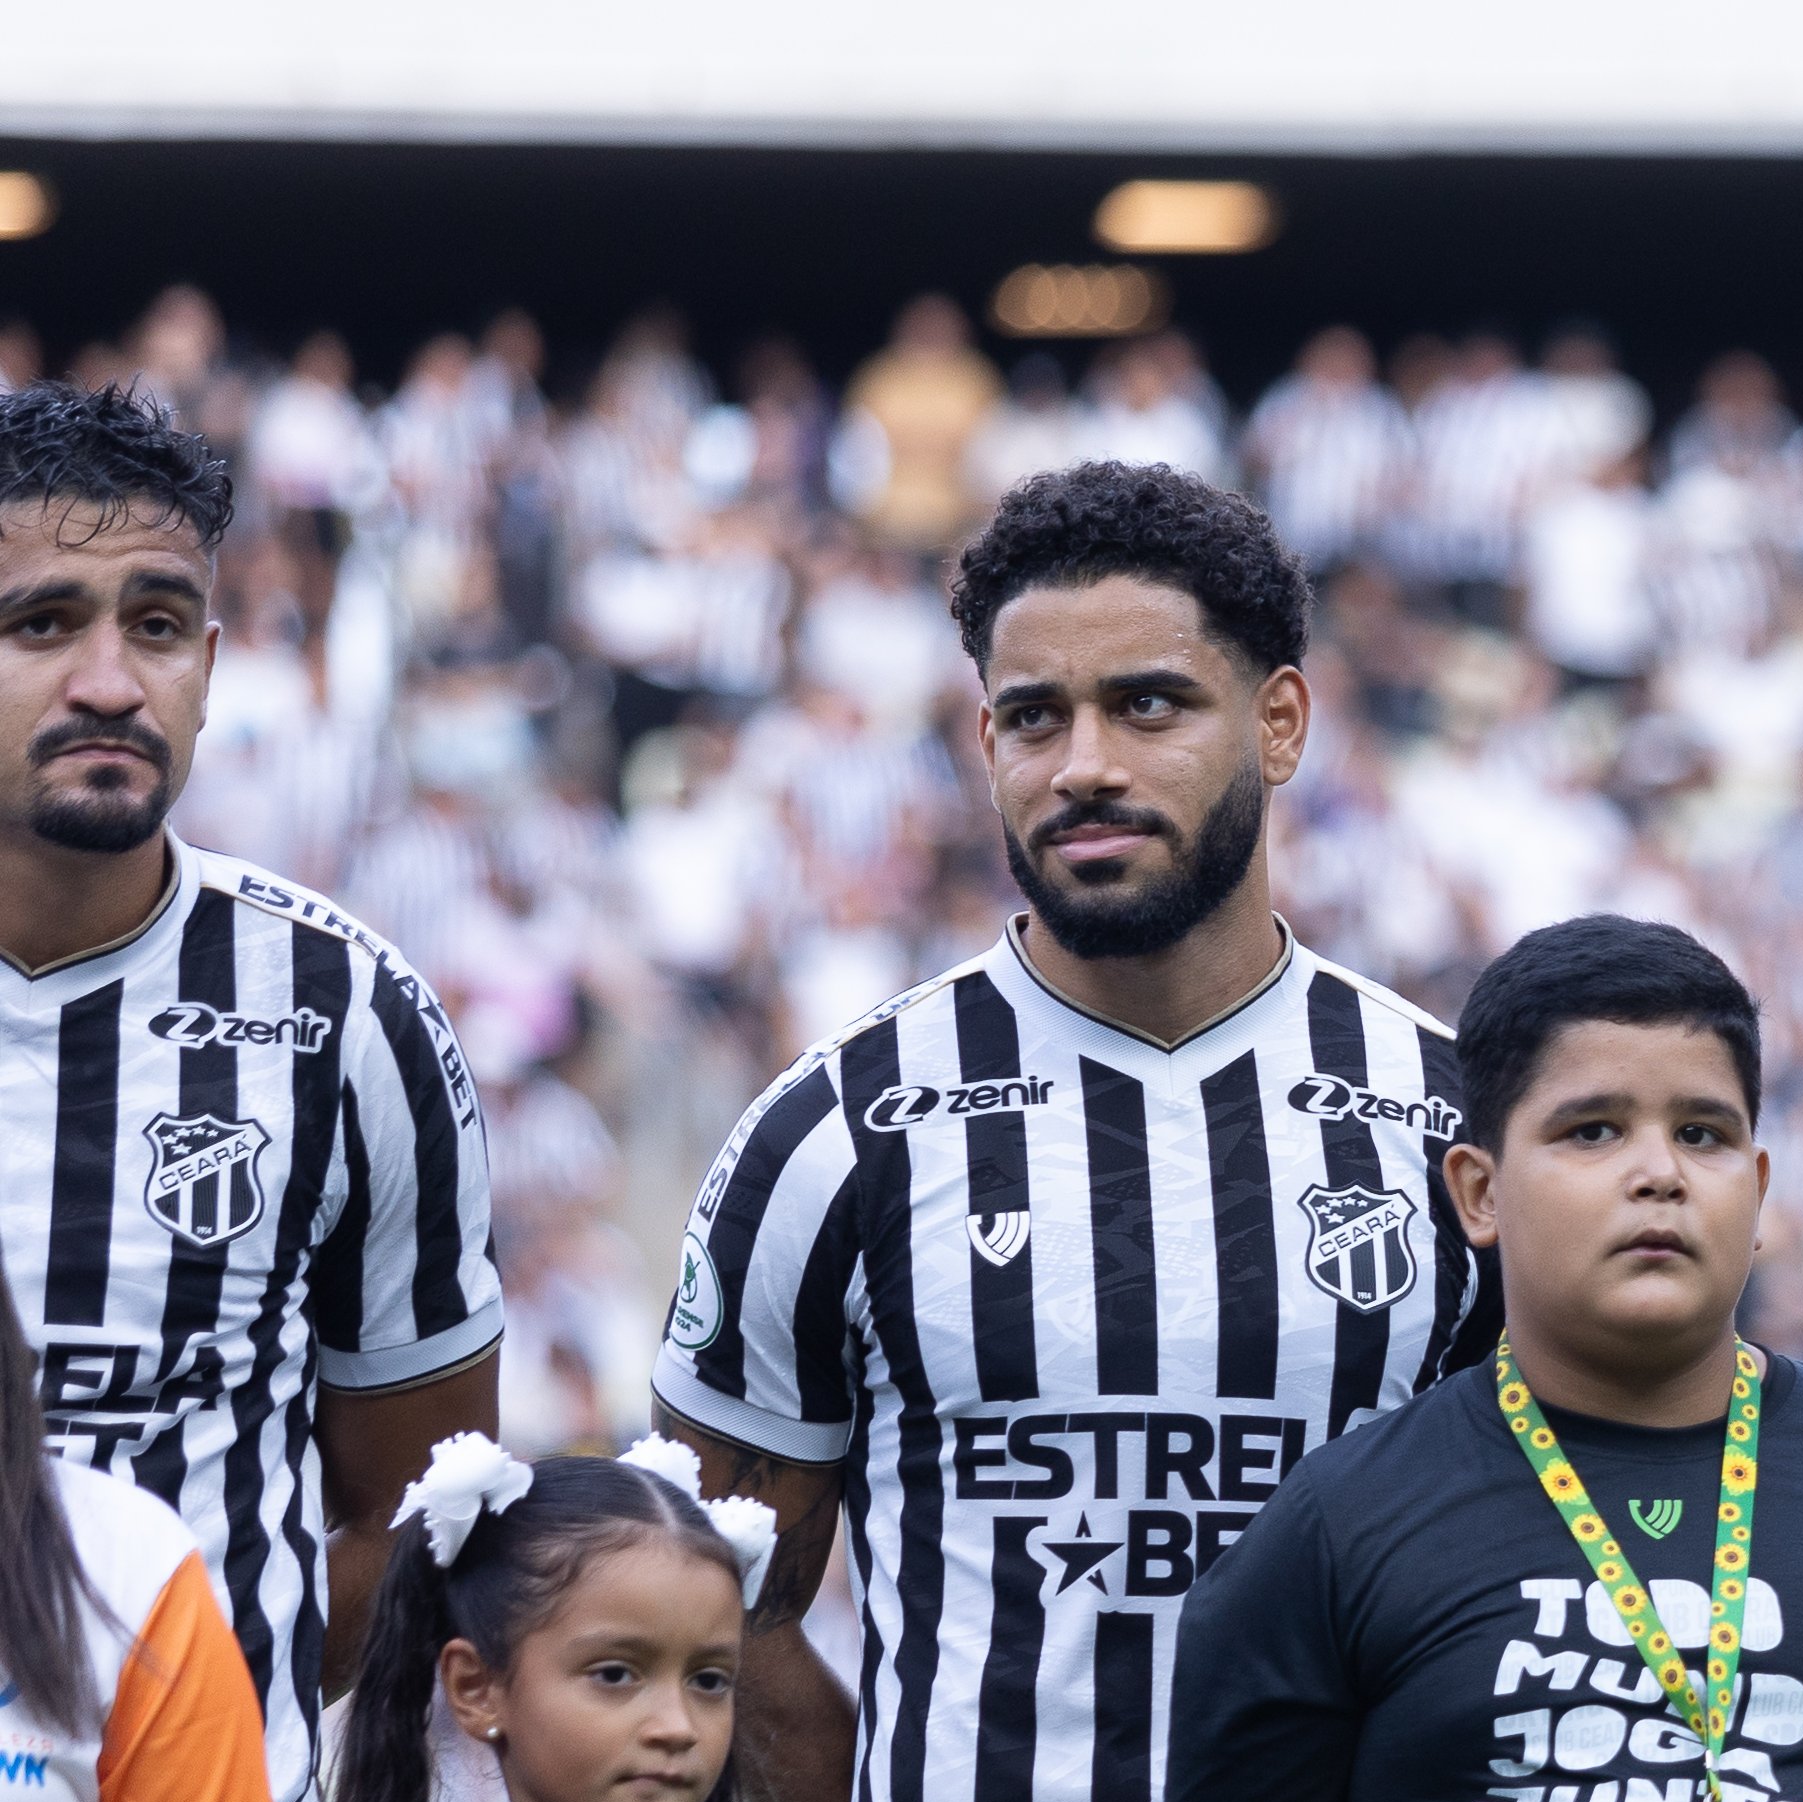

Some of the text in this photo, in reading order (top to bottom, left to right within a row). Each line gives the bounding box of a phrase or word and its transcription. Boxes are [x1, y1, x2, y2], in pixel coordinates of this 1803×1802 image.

[222, 1012, 326, 1047] zenir
[441, 1041, 478, 1130] BET
[945, 1075, 1055, 1114] zenir
[1356, 1092, 1457, 1136] zenir
[158, 1133, 254, 1190] CEARÁ
[1317, 1202, 1402, 1258] CEARÁ
[1520, 1577, 1784, 1652] TODO
[1488, 1704, 1781, 1793] JOGA
